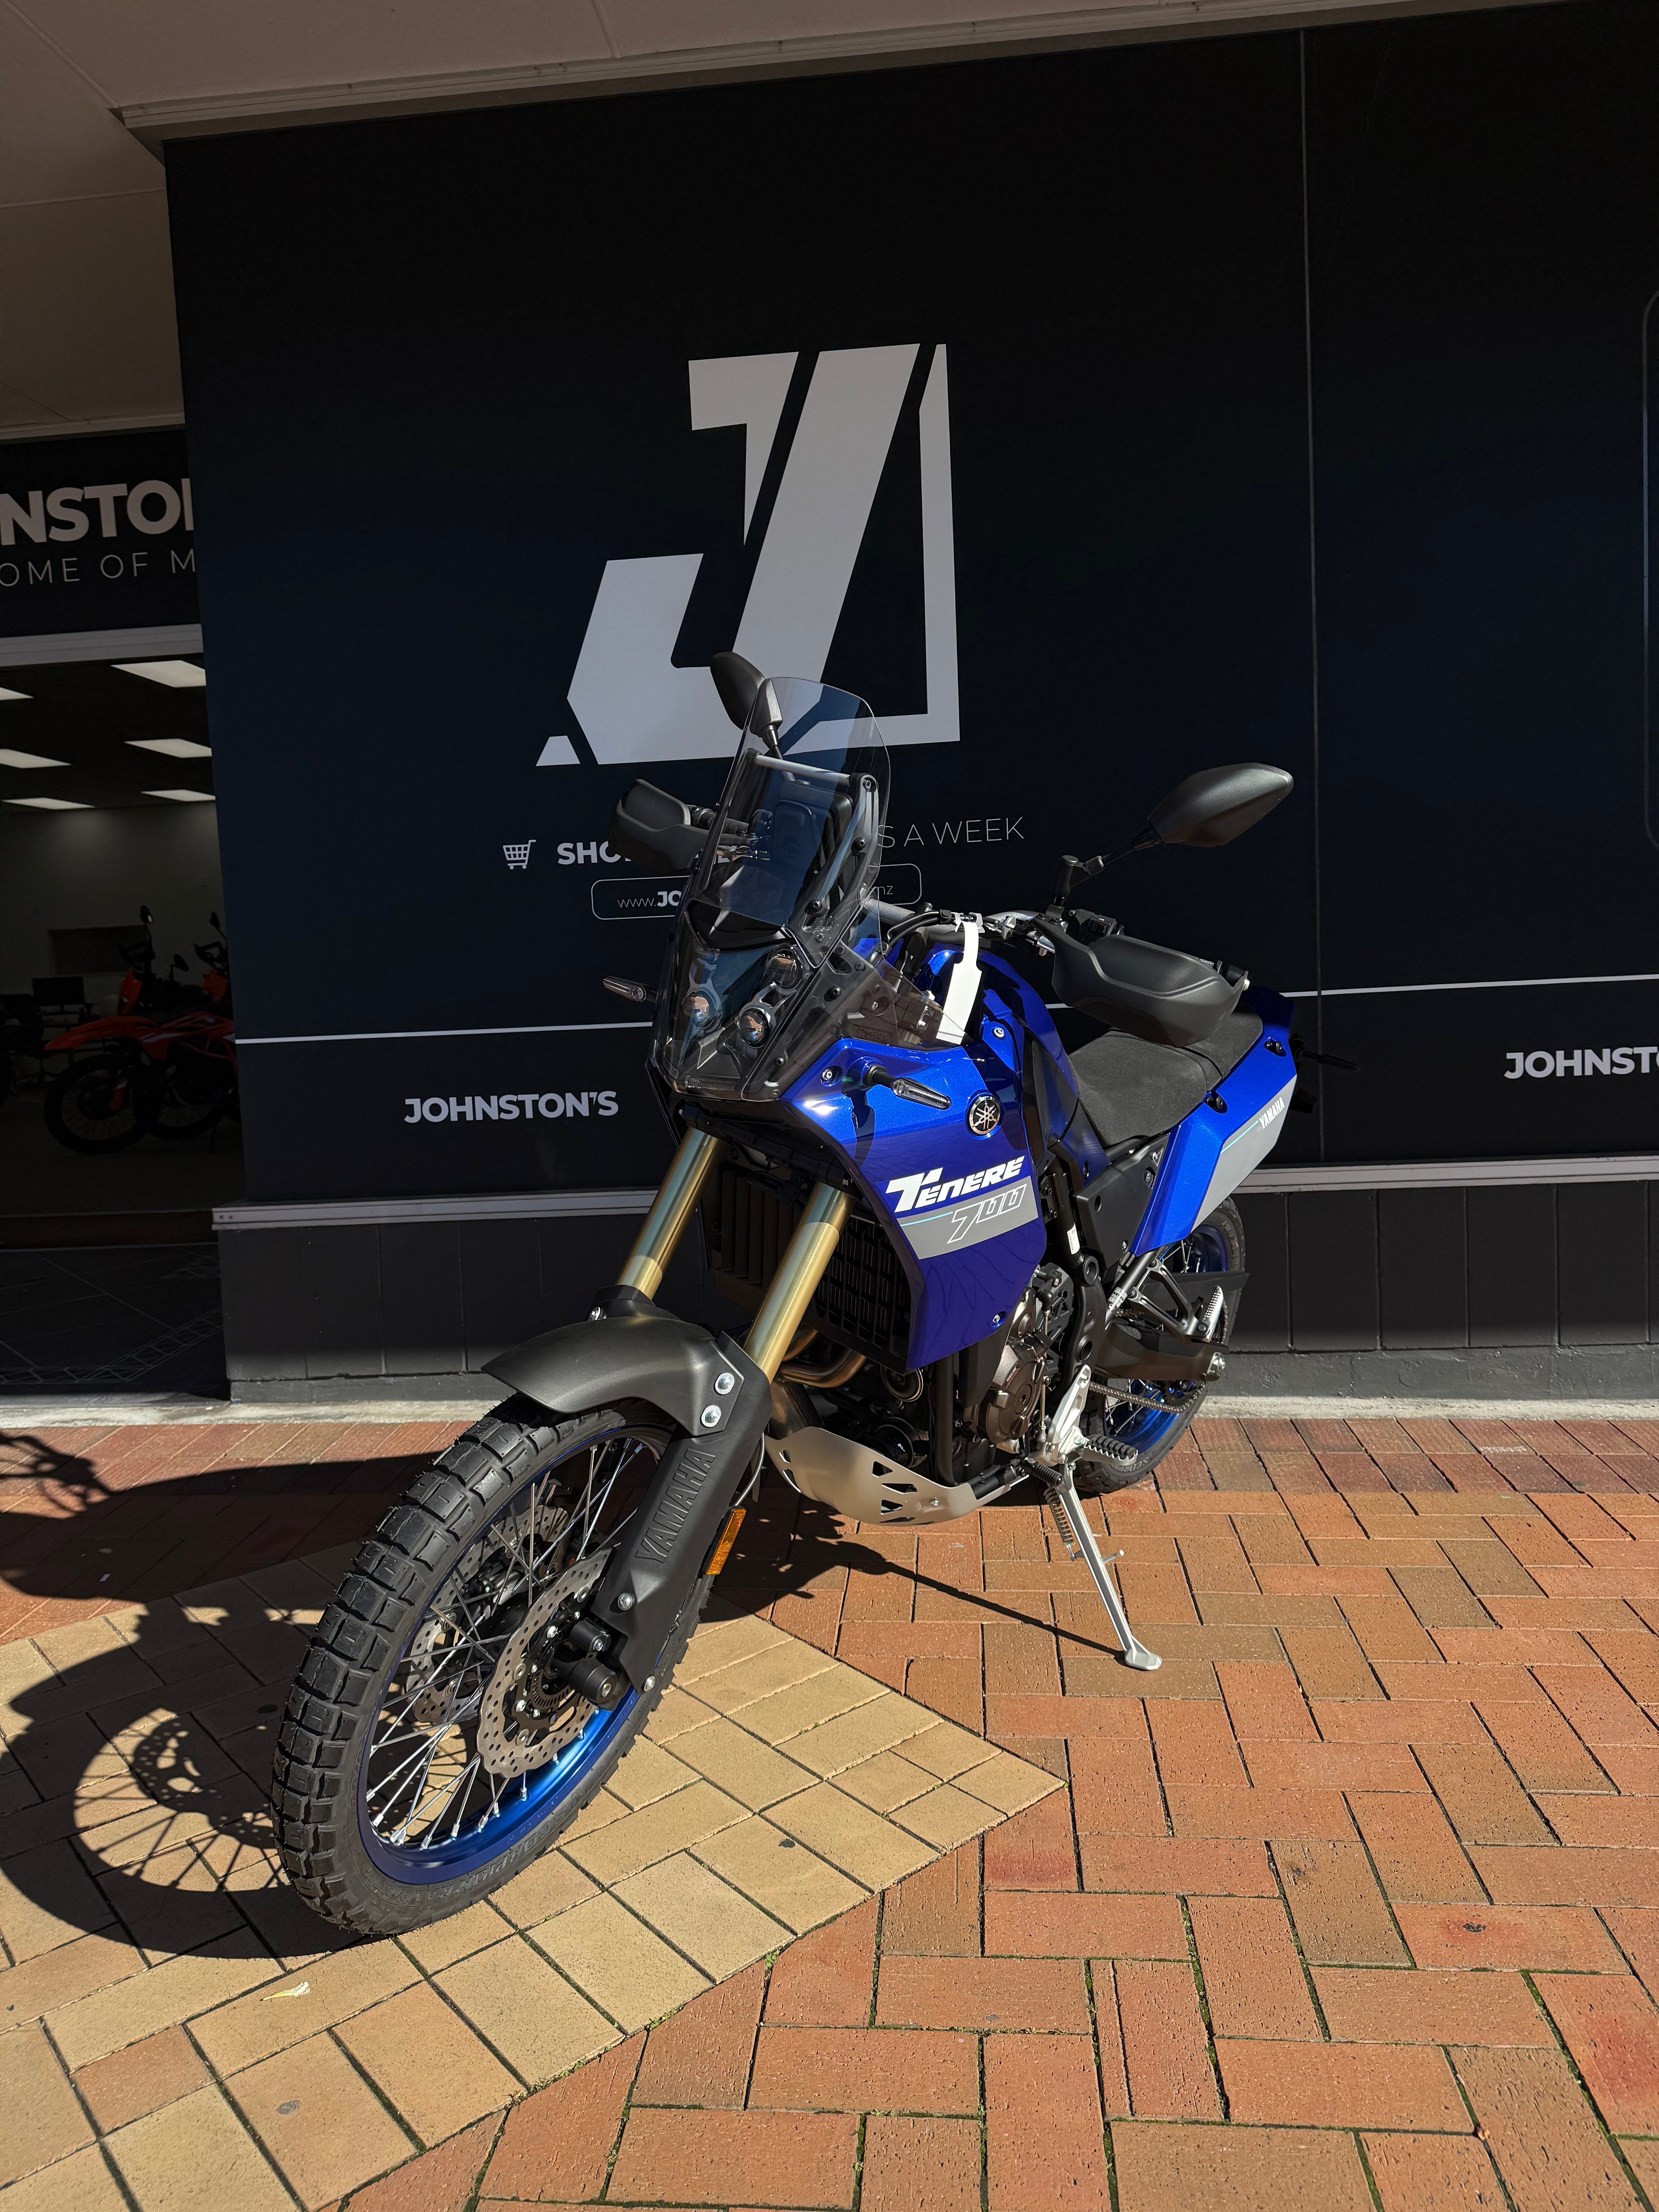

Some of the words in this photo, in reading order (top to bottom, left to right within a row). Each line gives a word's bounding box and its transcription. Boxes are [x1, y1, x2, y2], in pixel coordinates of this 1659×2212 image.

[100, 552, 148, 578] OF
[171, 548, 195, 574] M
[557, 841, 632, 865] SHO
[904, 824, 924, 847] A
[932, 816, 1024, 844] WEEK
[617, 891, 682, 908] www.JO
[1504, 1046, 1659, 1079] JOHNST
[404, 1091, 618, 1123] JOHNSTON'S
[1259, 1097, 1285, 1129] YAMAHA
[947, 1183, 1027, 1244] 700
[635, 1448, 716, 1563] YAMAHA
